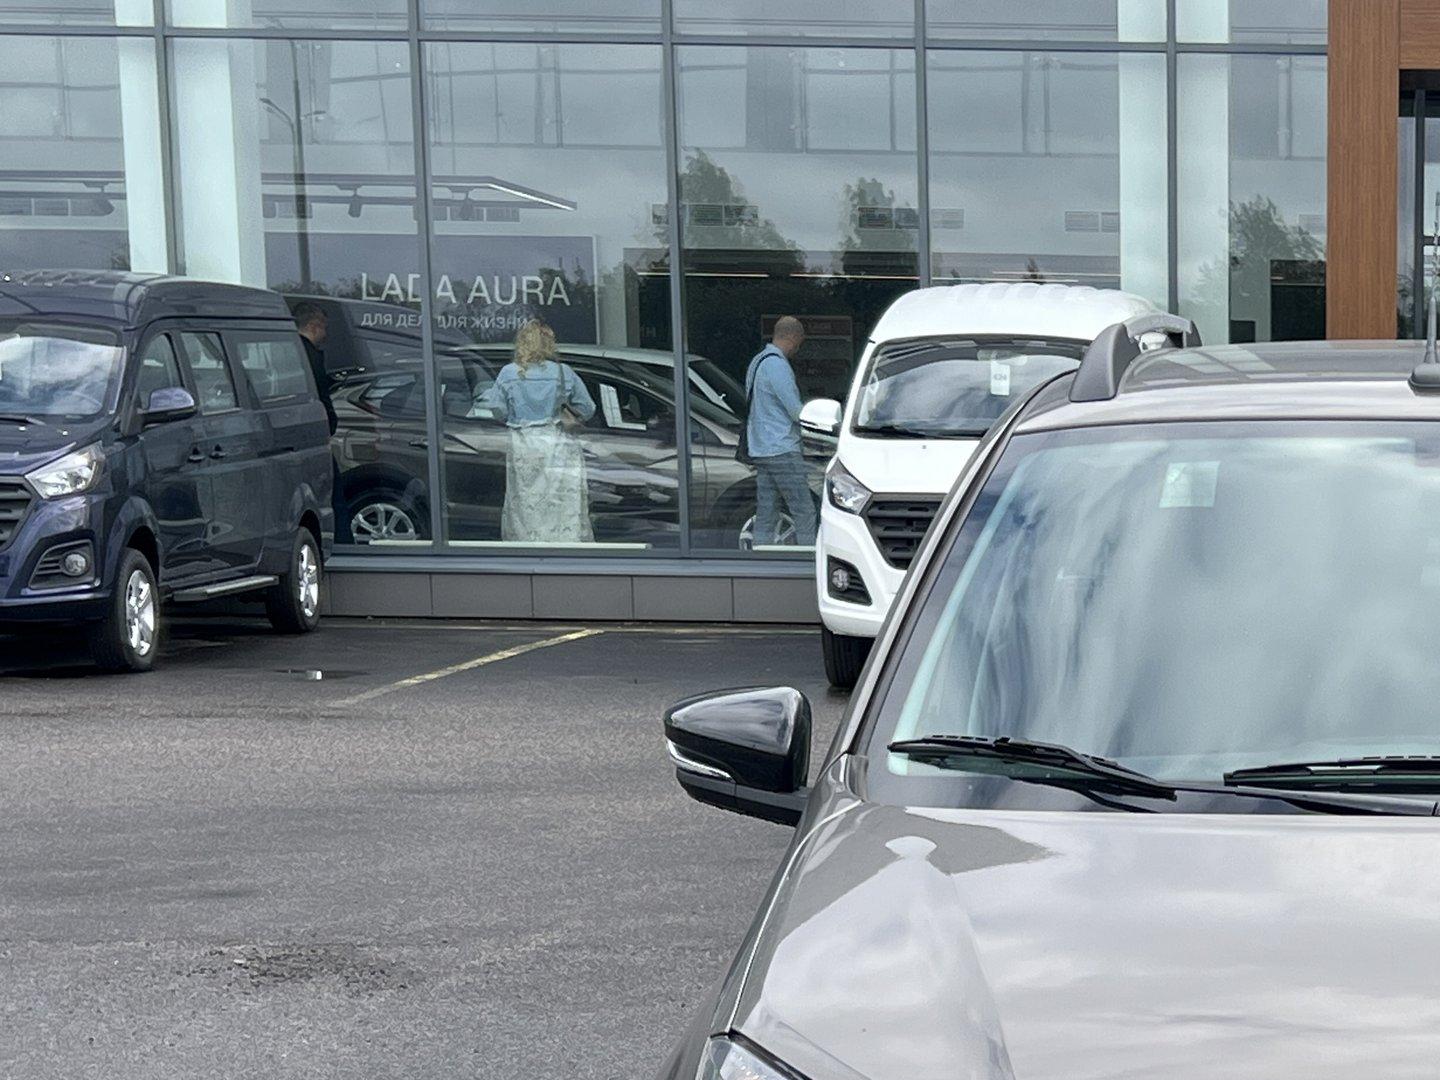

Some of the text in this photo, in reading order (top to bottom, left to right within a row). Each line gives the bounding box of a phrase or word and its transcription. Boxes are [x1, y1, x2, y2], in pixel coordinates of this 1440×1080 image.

[361, 273, 571, 306] LADA AURA
[361, 313, 393, 328] ДЛЯ
